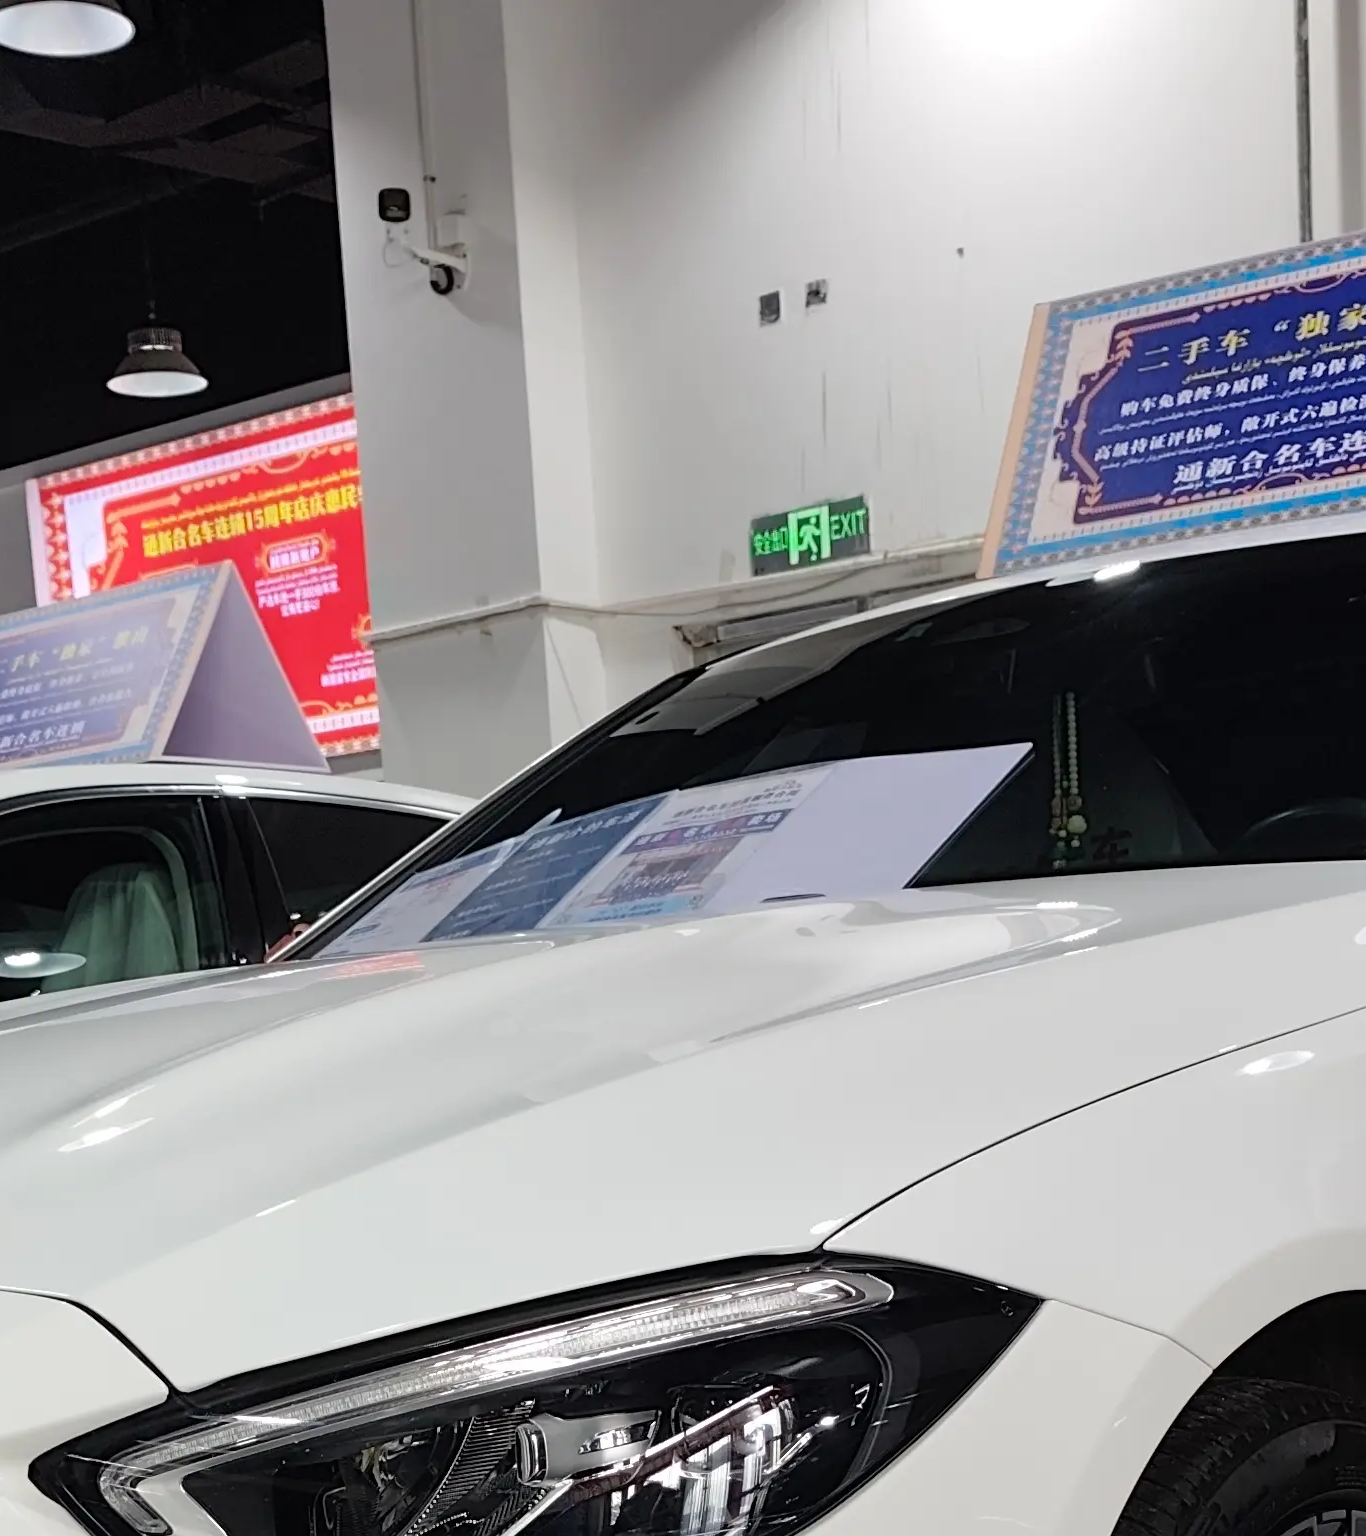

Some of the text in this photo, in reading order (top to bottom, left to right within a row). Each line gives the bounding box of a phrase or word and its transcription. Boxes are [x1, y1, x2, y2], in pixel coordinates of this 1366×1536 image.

[1137, 327, 1252, 374] 二手车
[830, 508, 867, 540] EXIT
